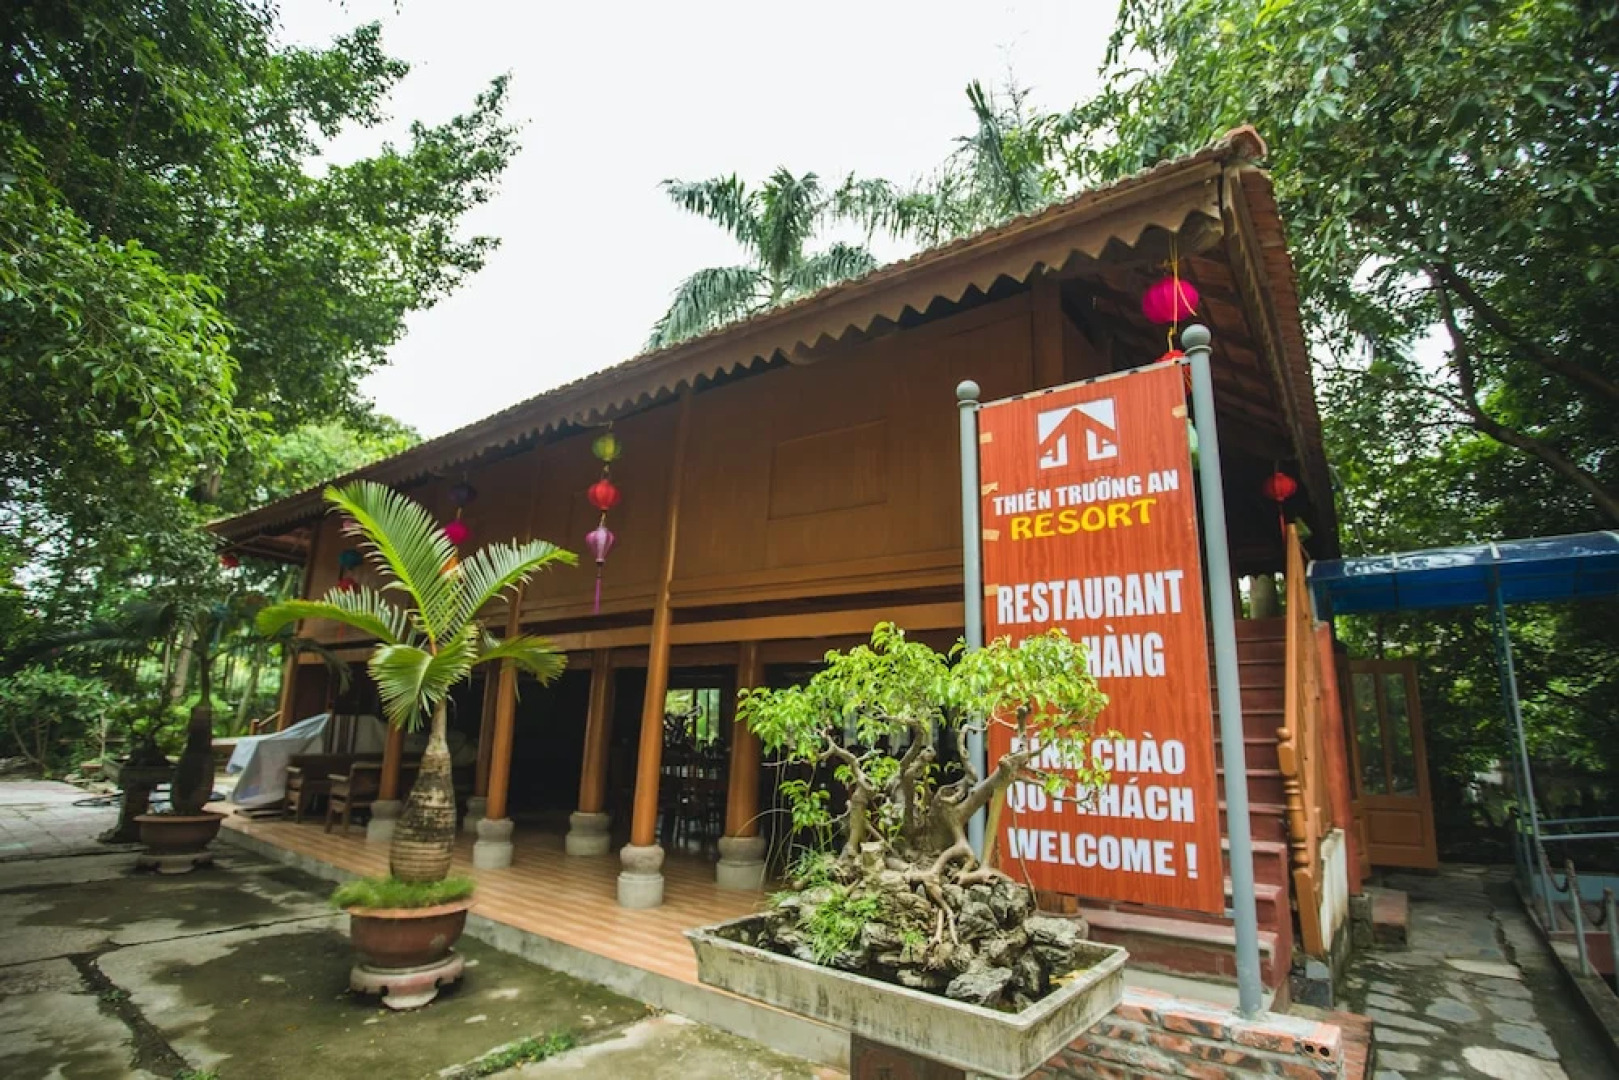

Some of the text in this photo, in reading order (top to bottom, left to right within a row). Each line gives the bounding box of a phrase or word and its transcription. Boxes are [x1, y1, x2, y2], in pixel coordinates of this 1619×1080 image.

[993, 469, 1179, 516] THIÊN TRƯỜNG AN
[1011, 498, 1157, 541] RESORT
[996, 569, 1183, 625] RESTAURANT
[1082, 624, 1165, 678] HÀNG
[1091, 731, 1186, 775] CHÀO
[1076, 777, 1195, 823] KHÁCH
[1007, 826, 1199, 879] WELCOME !
